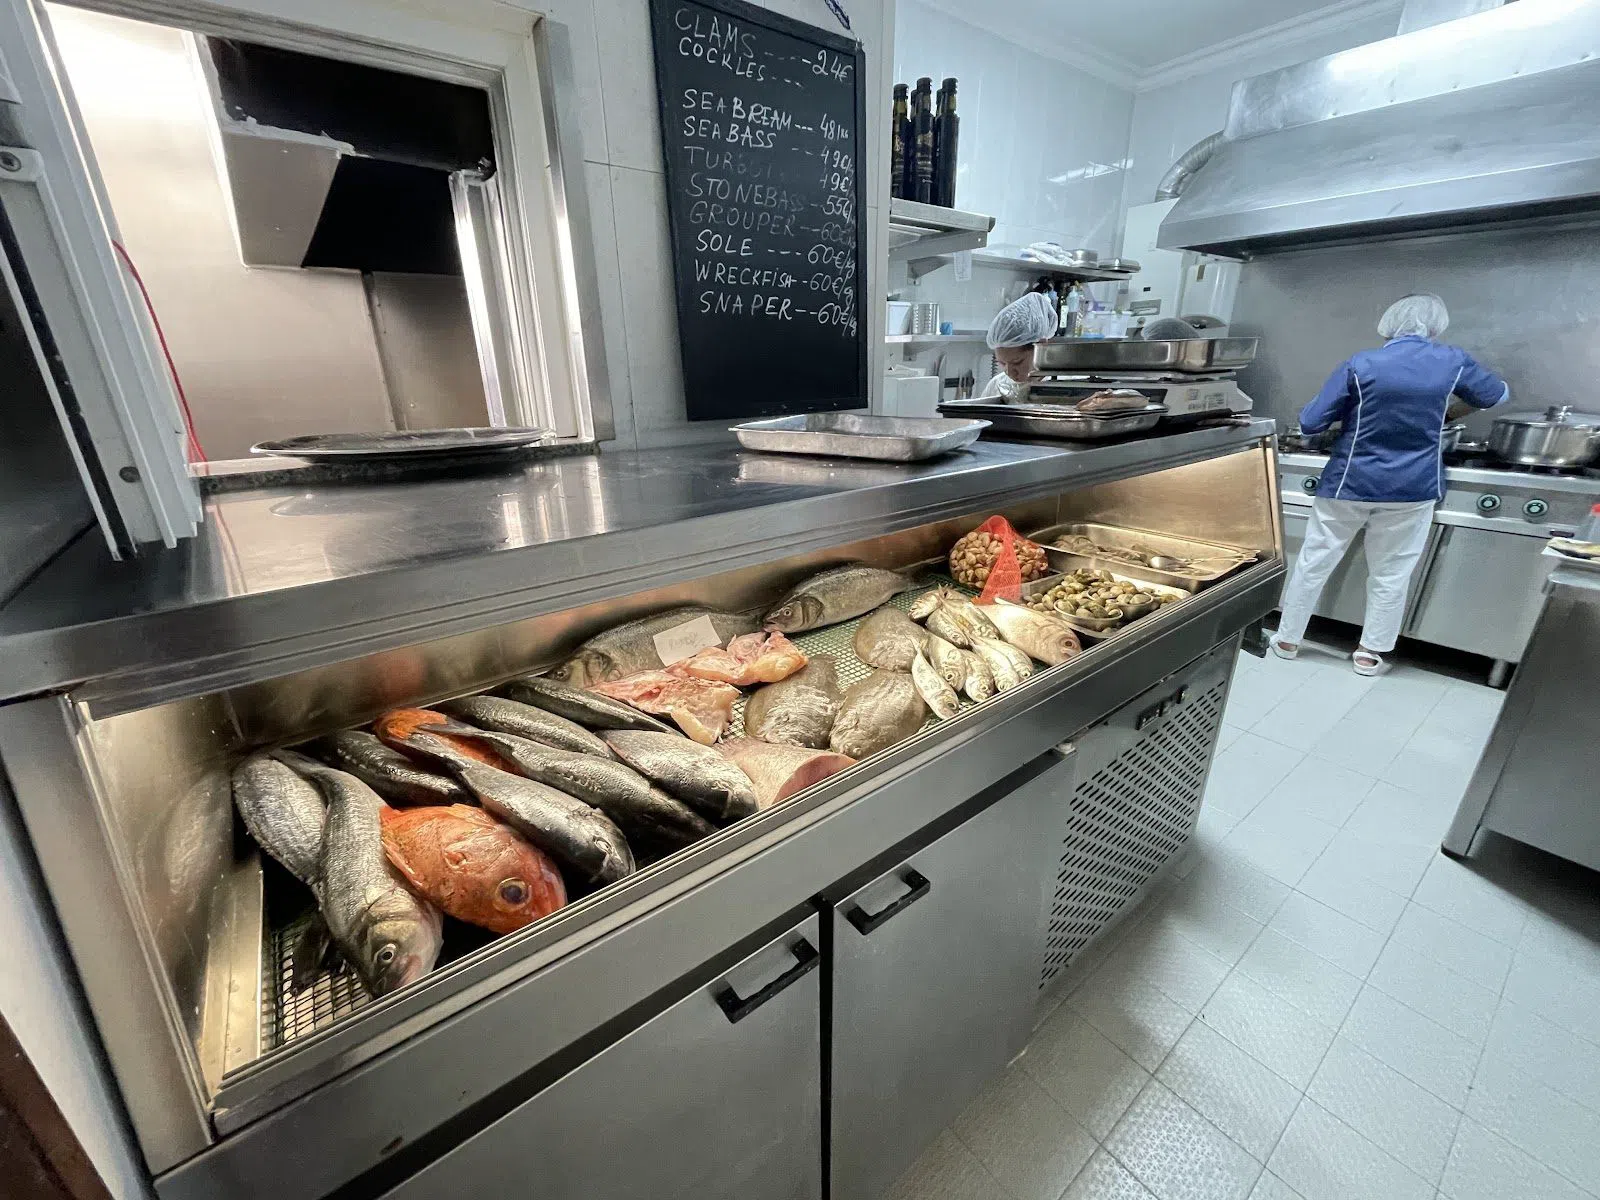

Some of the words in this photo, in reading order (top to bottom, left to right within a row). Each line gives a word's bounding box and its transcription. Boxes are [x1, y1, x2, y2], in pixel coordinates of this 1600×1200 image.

[675, 8, 756, 58] CLAMS
[812, 50, 853, 82] 24€
[679, 37, 766, 81] COCKLES
[682, 89, 726, 114] SEA
[732, 97, 792, 130] BREAM
[690, 201, 796, 236] GROUPER
[696, 229, 753, 256] SOLE
[700, 291, 793, 321] SNAPER
